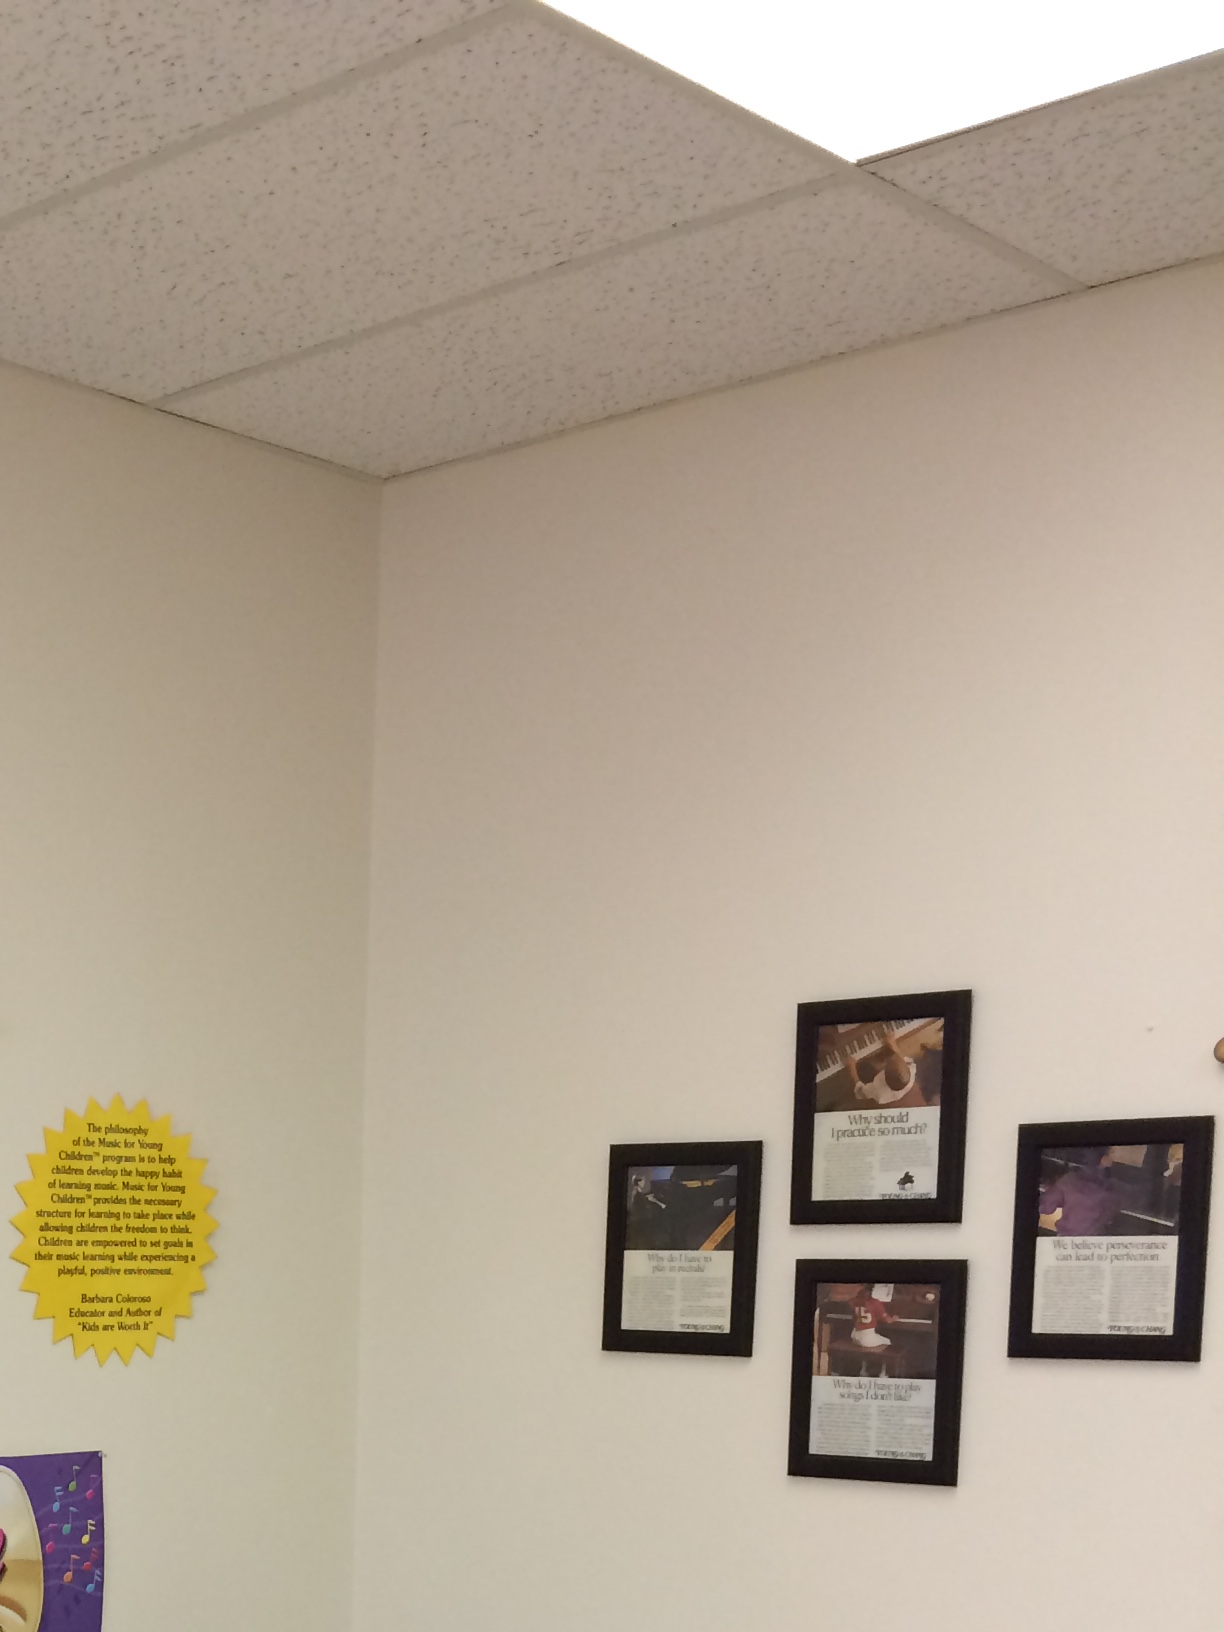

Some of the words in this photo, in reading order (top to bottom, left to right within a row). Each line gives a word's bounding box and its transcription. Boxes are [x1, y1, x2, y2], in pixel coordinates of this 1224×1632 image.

[848, 1114, 871, 1126] Why
[874, 1112, 909, 1124] should
[87, 1123, 102, 1133] The
[105, 1125, 149, 1136] philosophy
[832, 1128, 834, 1138] I
[878, 1128, 890, 1136] so
[892, 1124, 927, 1135] much?
[73, 1137, 80, 1147] of
[83, 1138, 95, 1147] the
[98, 1138, 120, 1148] Music
[124, 1139, 135, 1148] for
[138, 1140, 163, 1151] Young
[103, 1154, 136, 1164] program
[139, 1154, 145, 1163] is
[147, 1155, 156, 1163] to
[159, 1155, 176, 1166] help
[52, 1166, 84, 1175] children
[87, 1167, 118, 1178] develop
[121, 1168, 132, 1177] the
[135, 1168, 160, 1179] happy
[162, 1169, 182, 1178] habit
[48, 1180, 56, 1189] of
[59, 1181, 91, 1192] learning
[122, 1182, 144, 1191] Music
[147, 1182, 158, 1192] for
[161, 1183, 185, 1194] Young
[93, 1195, 126, 1207] provides
[129, 1196, 141, 1206] the
[36, 1209, 71, 1218] structure
[74, 1209, 85, 1218] for
[89, 1210, 120, 1221] learning
[123, 1211, 131, 1219] to
[133, 1211, 150, 1220] take
[152, 1211, 173, 1222] place
[175, 1212, 195, 1221] while
[39, 1223, 73, 1234] allowing
[76, 1224, 108, 1233] children
[111, 1224, 123, 1233] the
[125, 1224, 157, 1234] freedom
[160, 1225, 168, 1234] to
[38, 1237, 72, 1247] Children
[76, 1239, 88, 1247] are
[91, 1238, 137, 1249] empowered
[139, 1239, 147, 1247] to
[150, 1239, 161, 1248] set
[163, 1239, 183, 1250] goals
[185, 1239, 193, 1248] in
[1053, 1240, 1068, 1249] We
[1071, 1240, 1102, 1249] believe
[1106, 1241, 1168, 1252] perseverance
[34, 1252, 53, 1260] their
[56, 1252, 79, 1261] music
[82, 1252, 115, 1263] learning
[118, 1253, 137, 1261] while
[140, 1253, 188, 1264] experiencing
[1075, 1252, 1094, 1261] lead
[1111, 1252, 1159, 1264] perfection
[58, 1266, 87, 1277] playful,
[90, 1267, 120, 1277] positive
[81, 1294, 113, 1303] Barbara
[116, 1294, 151, 1303] Coloroso
[69, 1308, 105, 1318] Educator
[108, 1308, 123, 1317] and
[126, 1308, 151, 1317] Author
[154, 1307, 162, 1317] of
[102, 1324, 114, 1332] are
[117, 1322, 140, 1331] Worth
[833, 1379, 852, 1389] Why
[855, 1380, 866, 1389] do
[873, 1381, 893, 1391] have
[905, 1382, 921, 1392] play
[840, 1392, 863, 1402] songs
